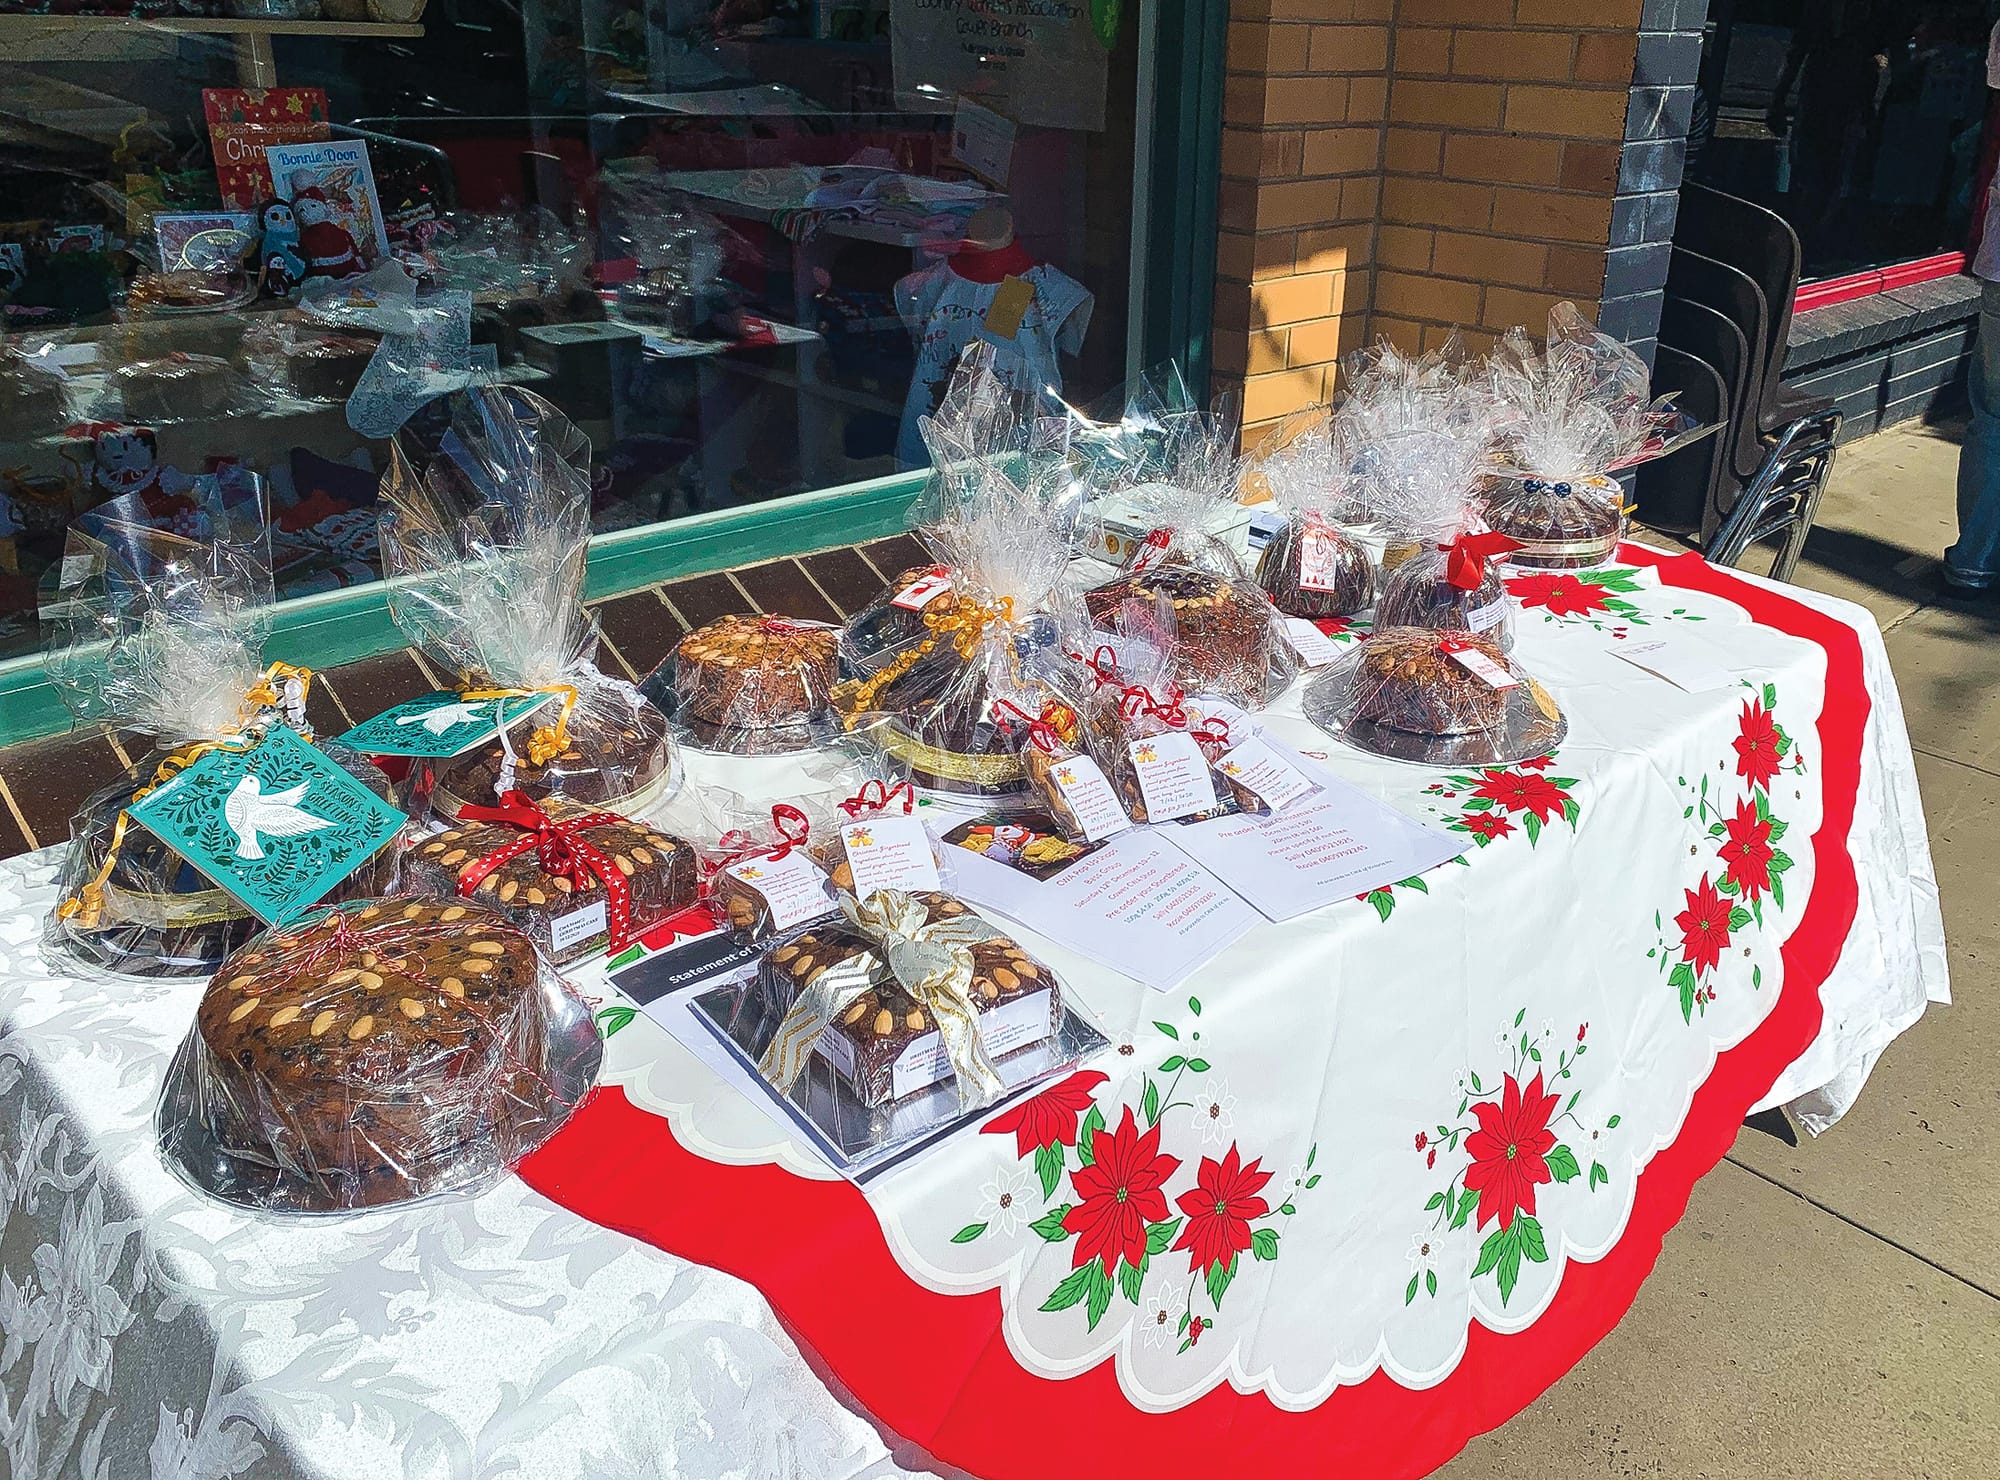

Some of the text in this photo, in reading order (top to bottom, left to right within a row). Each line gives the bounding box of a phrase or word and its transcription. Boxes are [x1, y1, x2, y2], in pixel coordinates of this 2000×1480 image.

[278, 149, 323, 166] Bonnie
[323, 148, 360, 162] Doon
[1111, 863, 1139, 883] December
[669, 953, 739, 984] Statement
[739, 946, 752, 957] of
